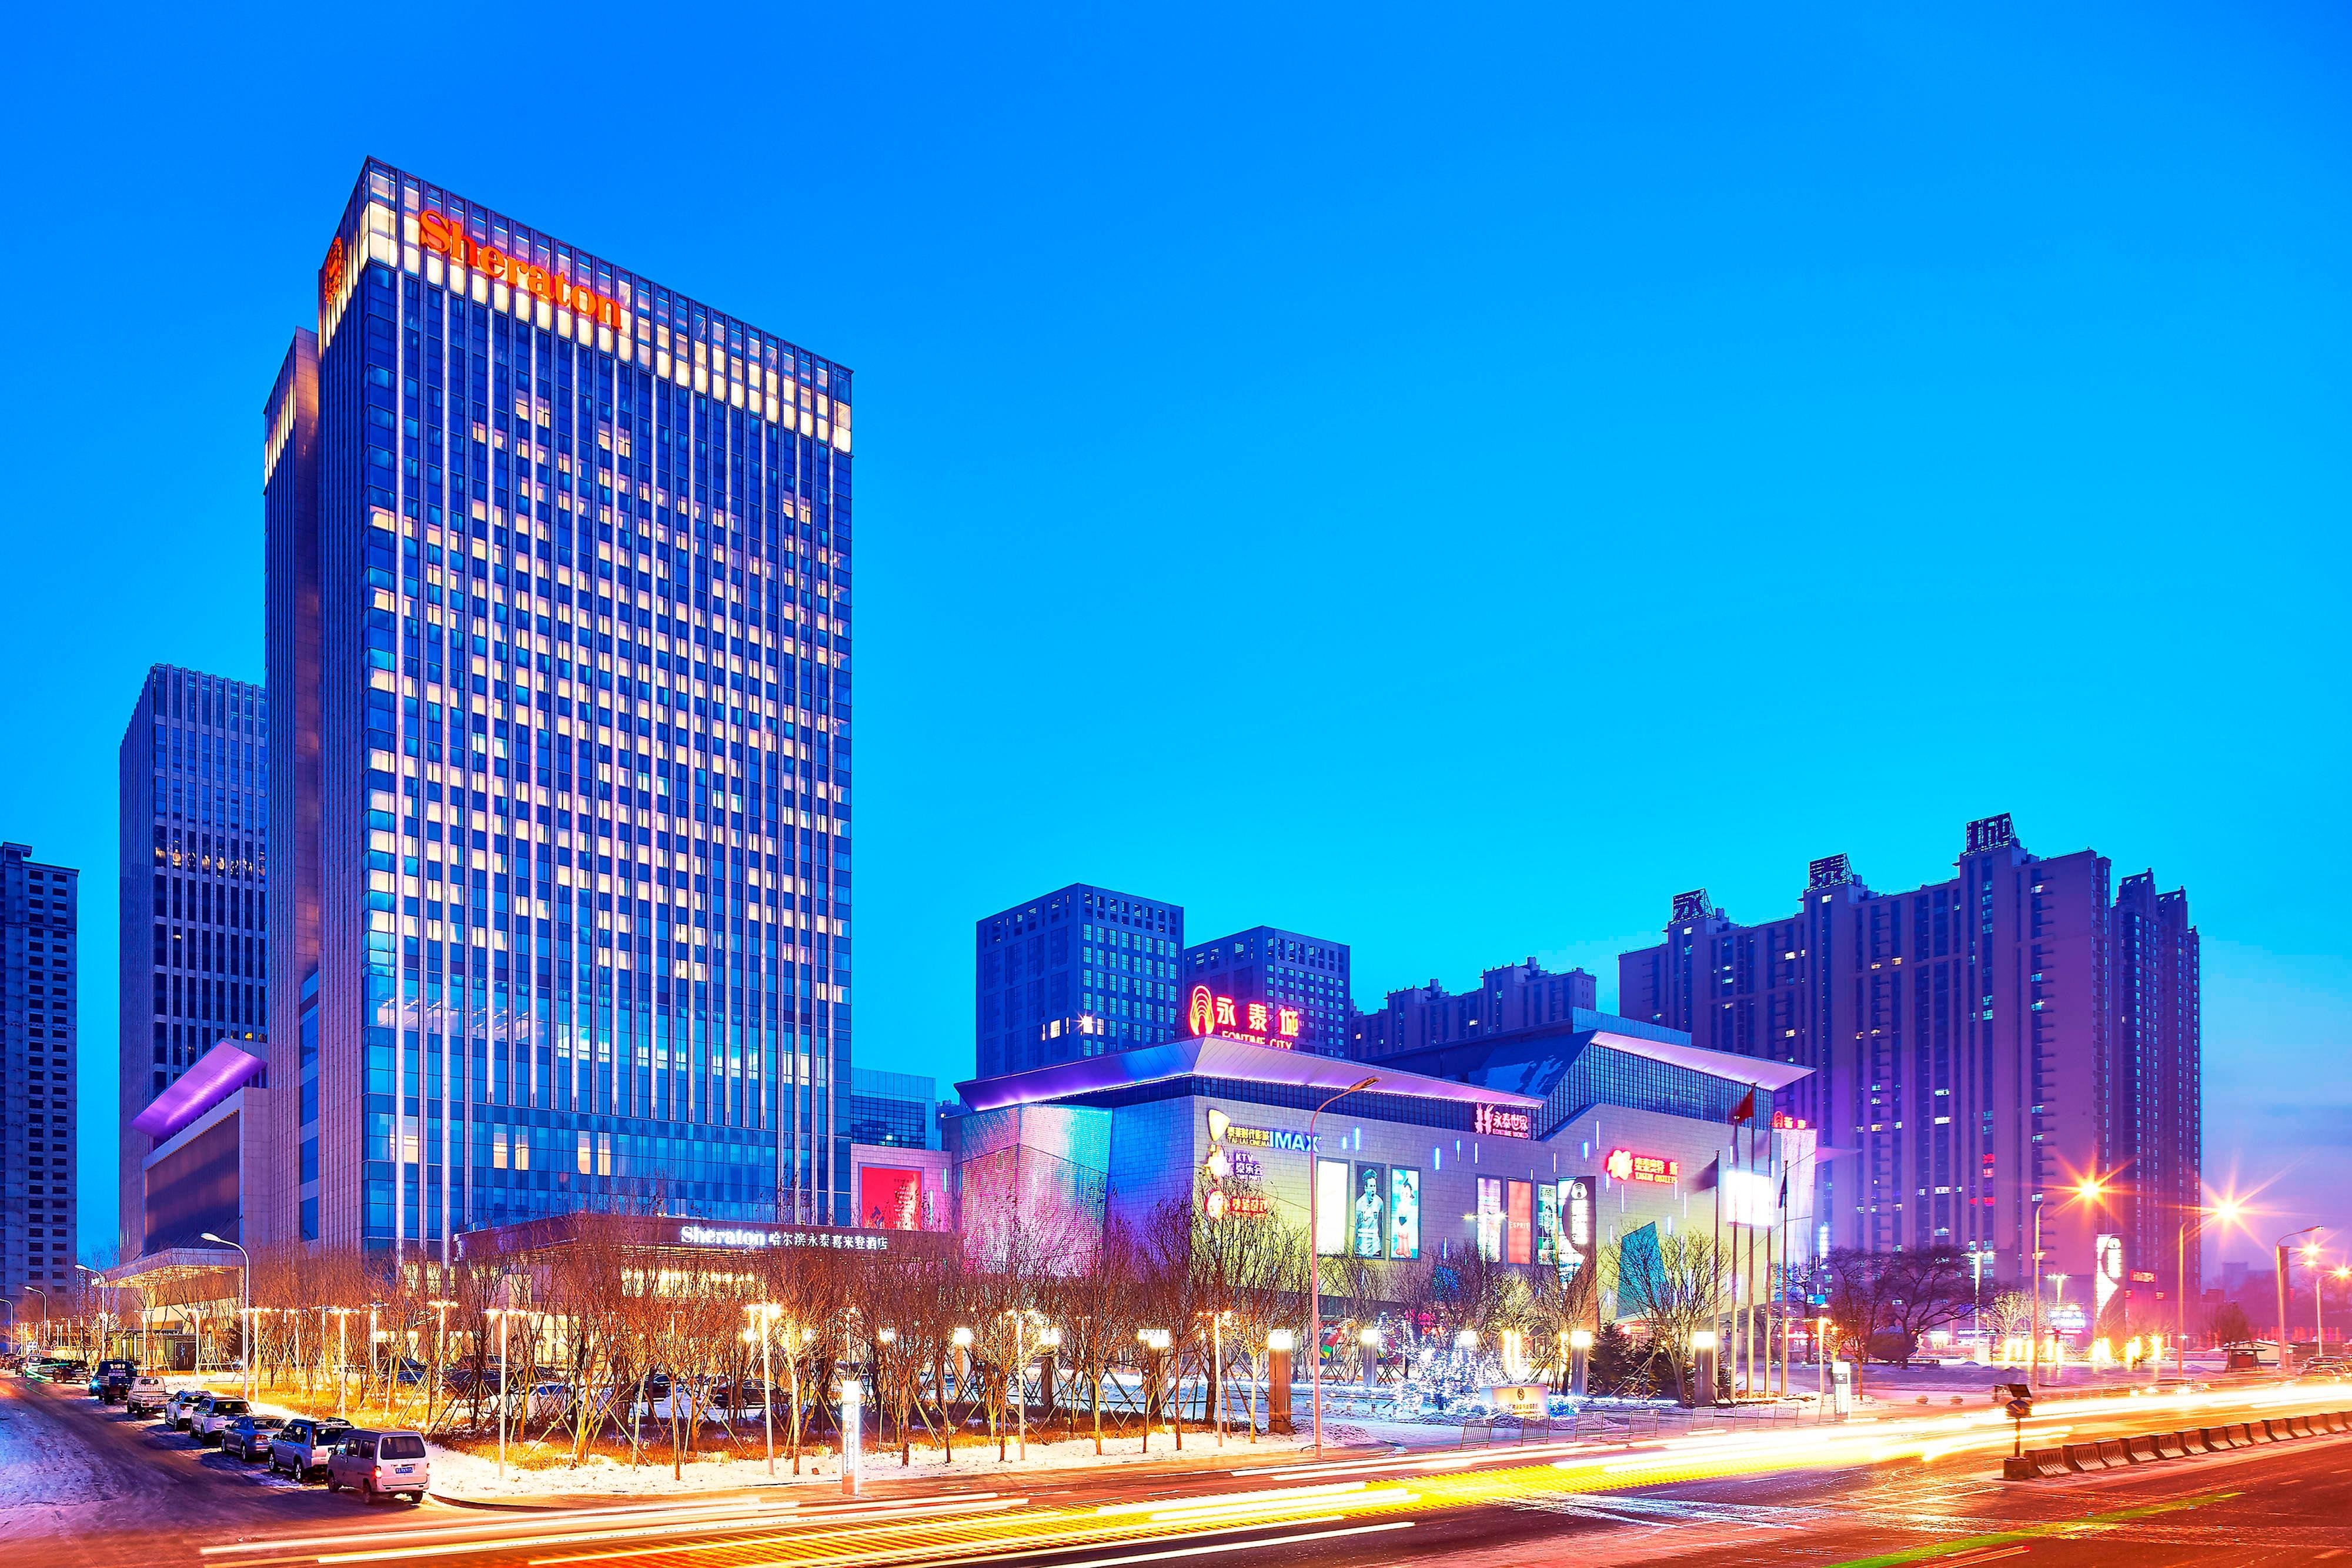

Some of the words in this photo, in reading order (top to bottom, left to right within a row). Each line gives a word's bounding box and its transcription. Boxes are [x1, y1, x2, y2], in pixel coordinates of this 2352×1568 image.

[420, 209, 623, 329] Sheraton
[1217, 997, 1299, 1037] 永泰城
[1269, 1038, 1292, 1050] CITY
[1493, 1111, 1528, 1131] 永泰世界
[1270, 1131, 1321, 1153] IMAX
[1235, 1152, 1254, 1162] KTV
[681, 1225, 764, 1246] Sheraton
[769, 1231, 888, 1251] 哈尔滨永泰喜来登酒店
